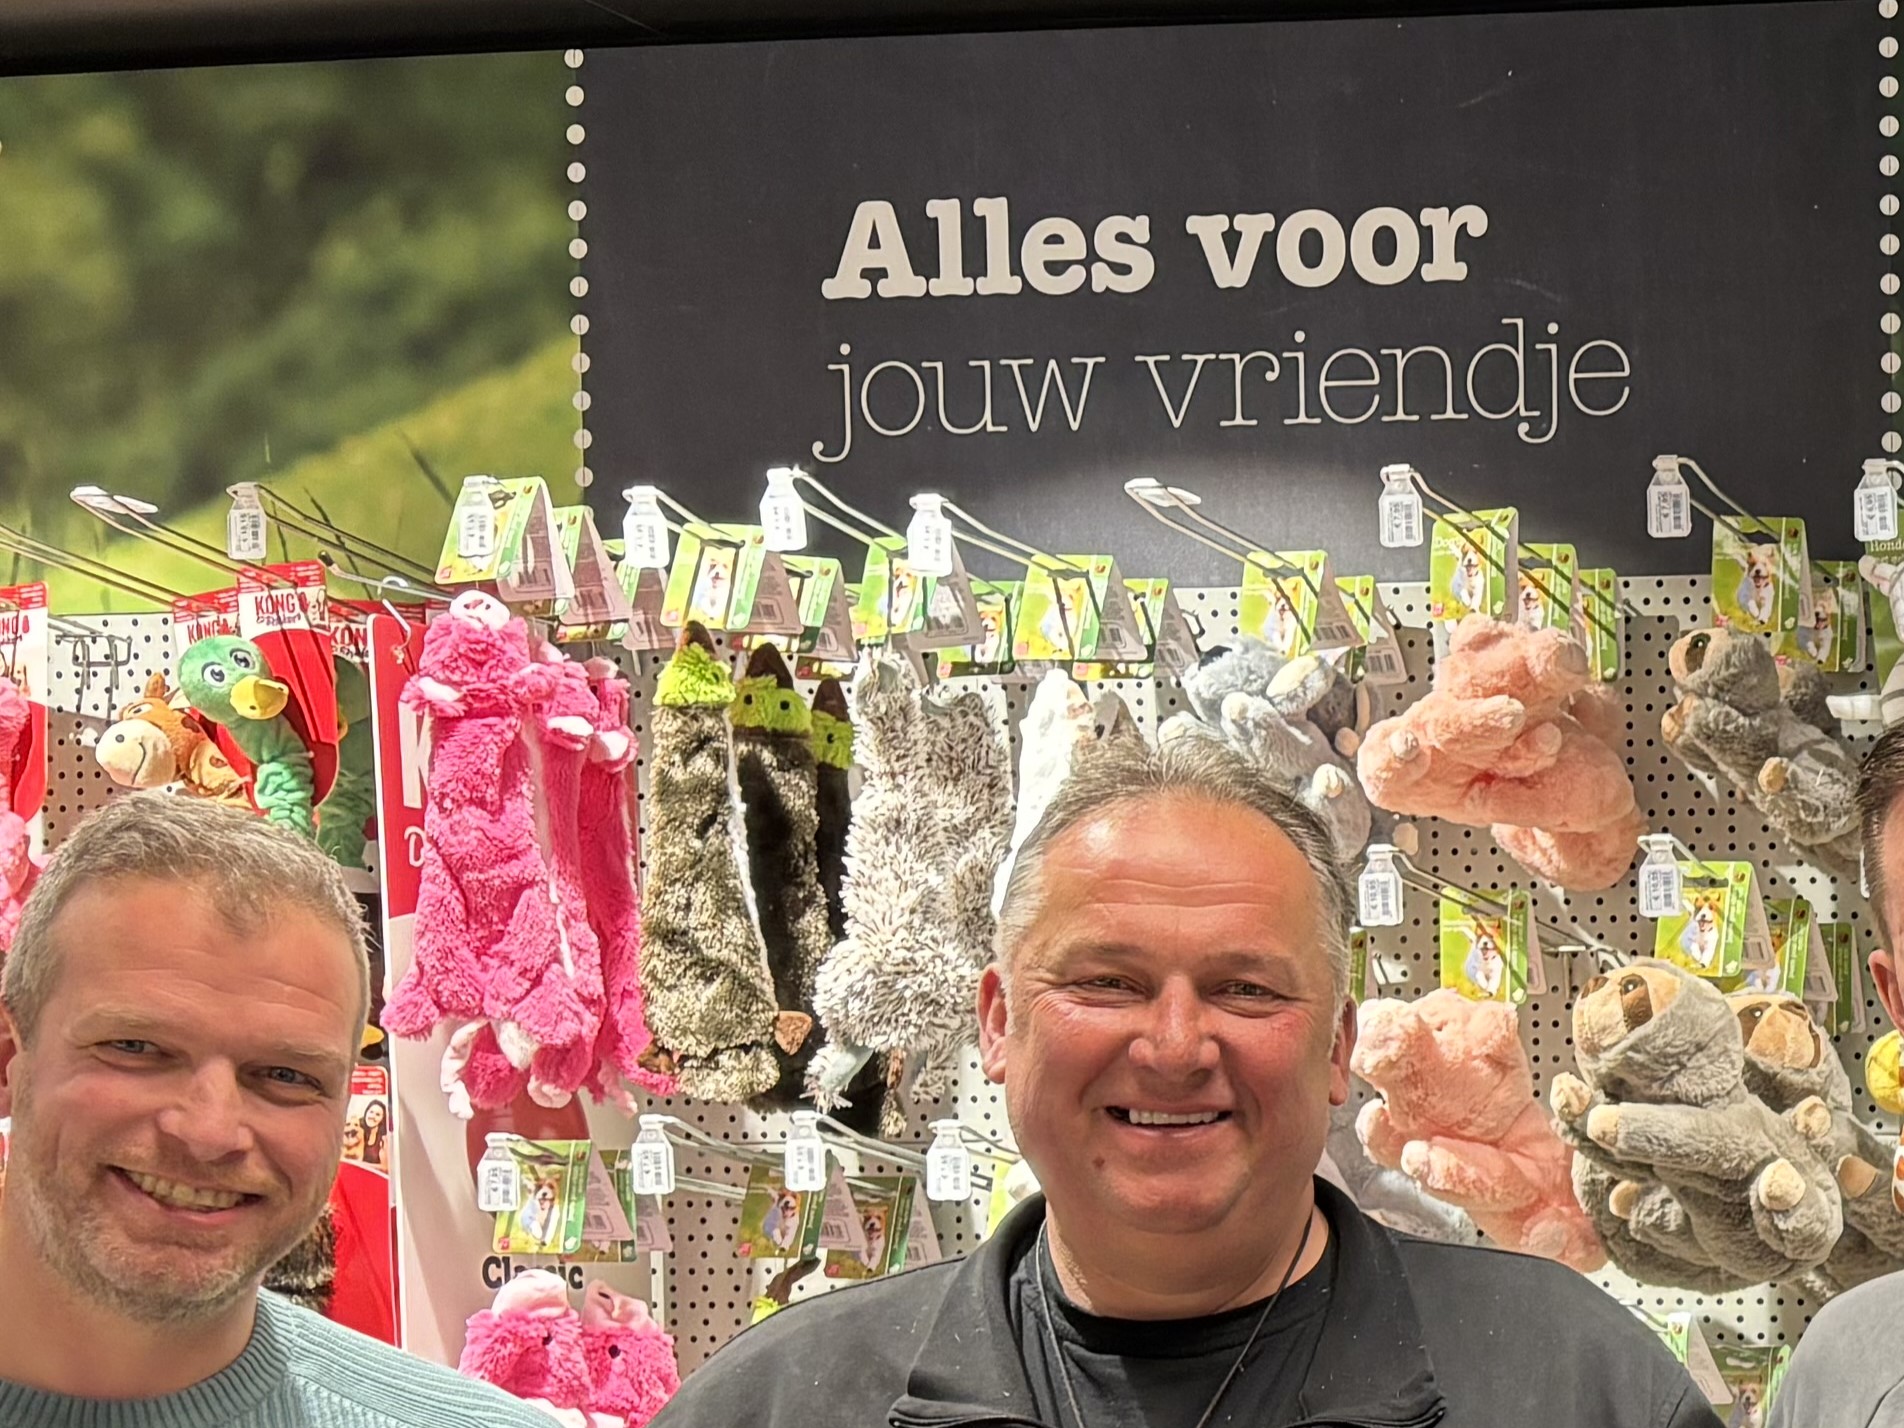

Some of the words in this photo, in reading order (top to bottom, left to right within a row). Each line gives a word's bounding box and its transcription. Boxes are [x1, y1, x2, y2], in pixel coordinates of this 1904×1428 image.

[822, 197, 1154, 299] Alles
[1186, 205, 1488, 288] voor
[812, 344, 1105, 462] jouw
[1135, 318, 1630, 443] vriendje
[254, 593, 296, 616] KONG
[331, 624, 368, 646] KON
[482, 1255, 583, 1289] Clic
